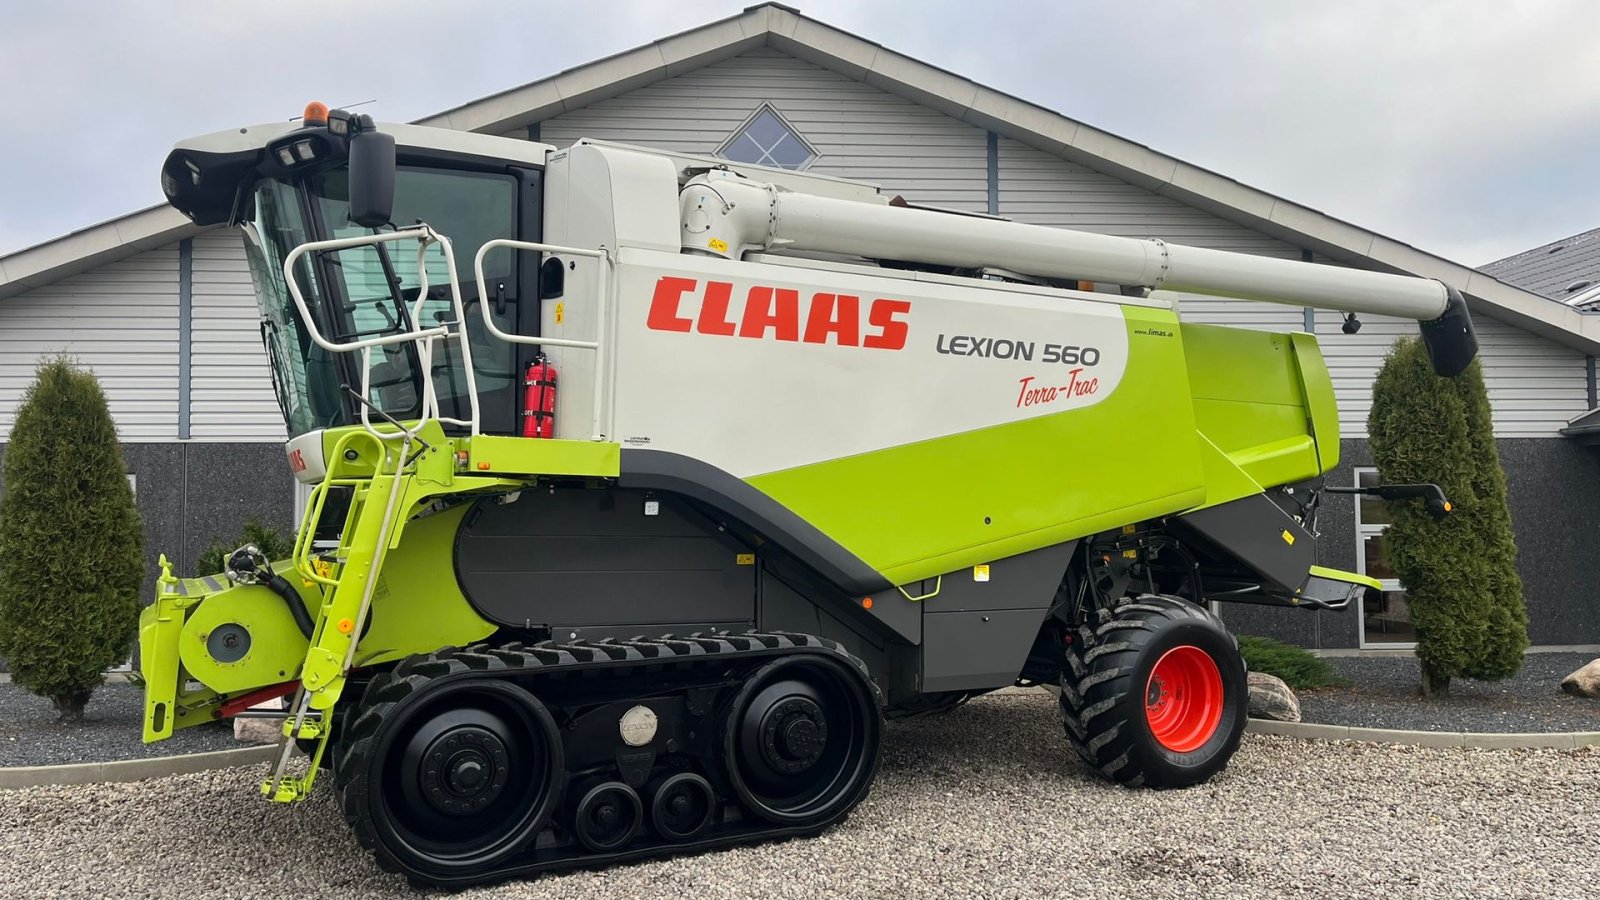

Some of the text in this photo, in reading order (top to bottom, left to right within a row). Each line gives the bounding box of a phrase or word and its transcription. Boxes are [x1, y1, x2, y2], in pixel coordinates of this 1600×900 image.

[646, 276, 912, 351] CLAAS
[936, 334, 1100, 367] LEXION 560
[1017, 368, 1099, 408] Terra-Trac
